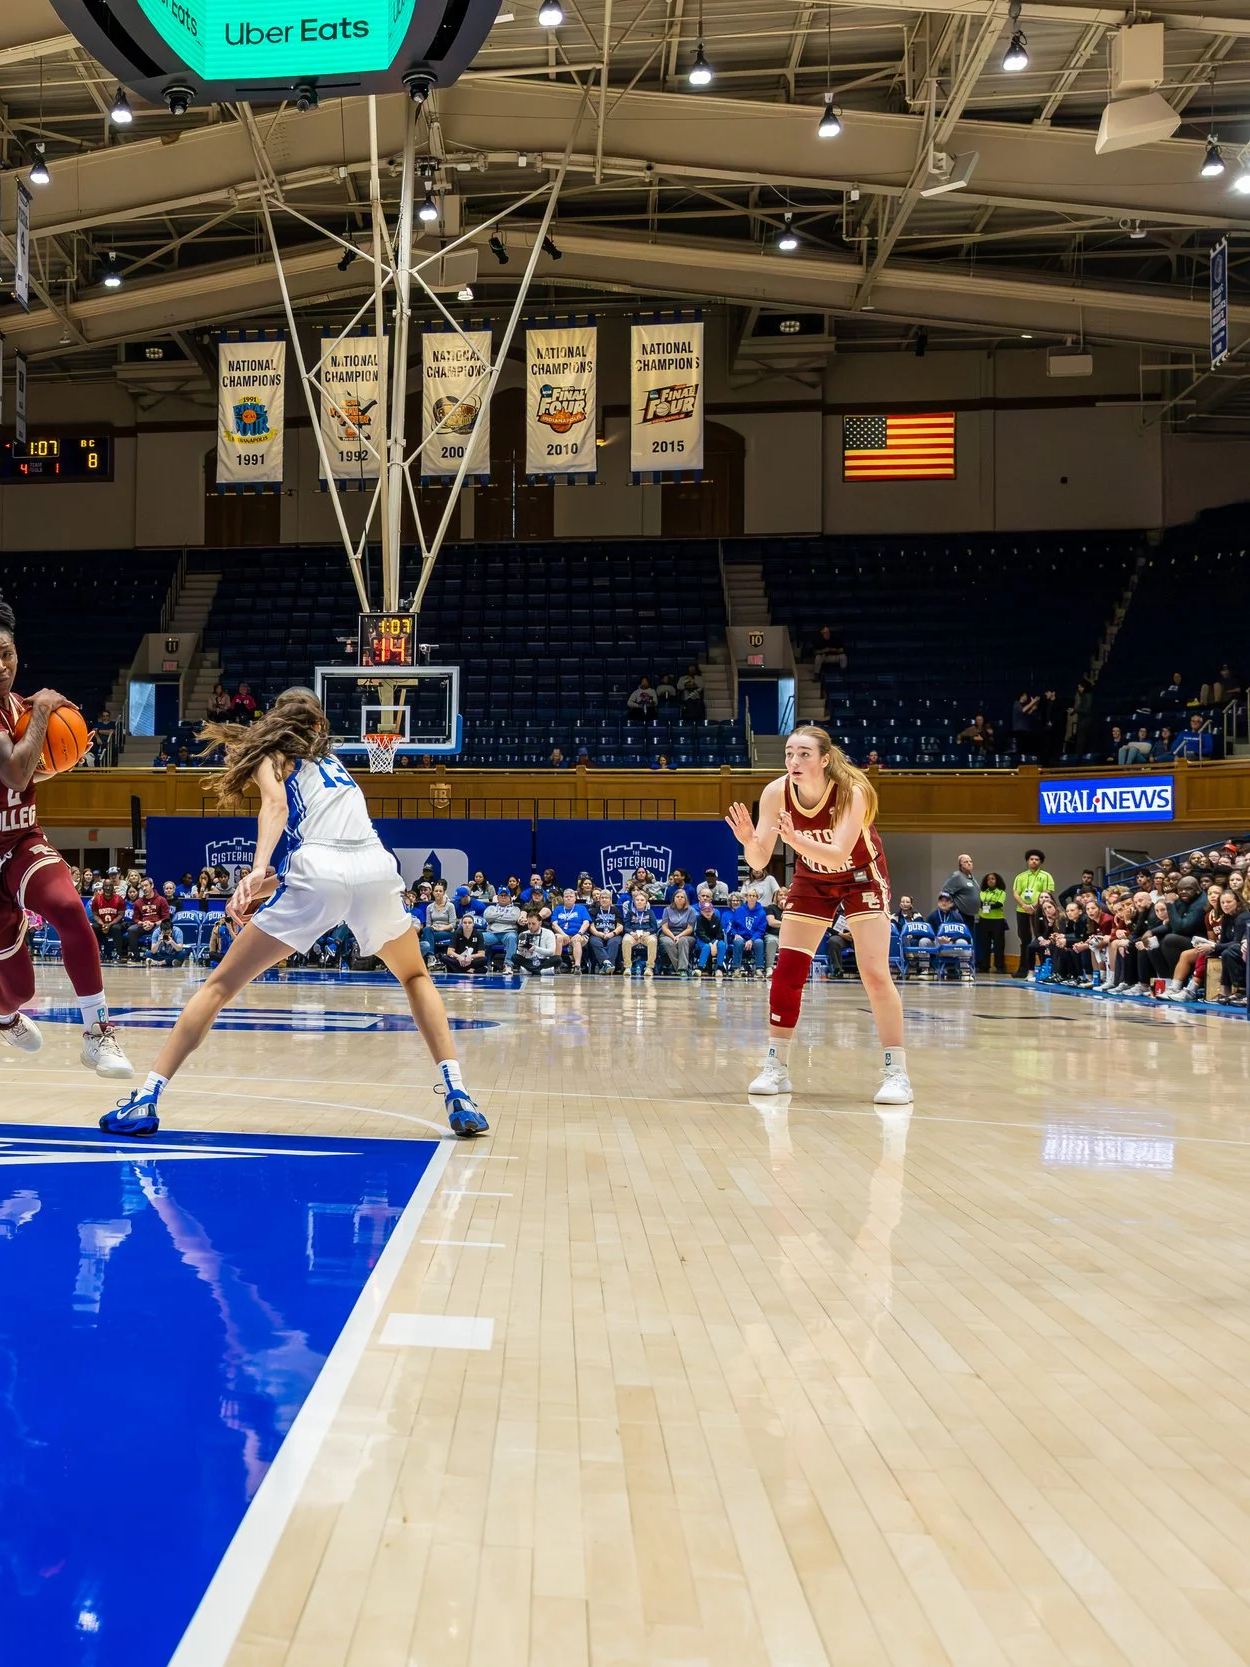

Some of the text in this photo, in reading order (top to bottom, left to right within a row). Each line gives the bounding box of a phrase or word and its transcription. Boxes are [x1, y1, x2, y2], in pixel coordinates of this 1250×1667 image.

[225, 17, 370, 46] Uber Eats
[536, 346, 587, 360] NATIONAL
[642, 341, 693, 355] NATIONAL
[228, 359, 276, 372] NATIONAL
[331, 354, 378, 367] NATIONAL
[635, 357, 700, 372] CHAMPIONS
[531, 361, 593, 376] CHAMPIONS
[222, 374, 281, 388] CHAMPIONS
[325, 370, 378, 383] CHAMPION
[552, 388, 586, 401] FINAL
[661, 387, 696, 402] FINAL
[538, 398, 587, 416] FOUR
[30, 440, 58, 455] 1:07
[441, 446, 467, 458] 200
[546, 443, 579, 456] 2010
[652, 441, 685, 453] 2015
[88, 453, 98, 468] 8
[237, 454, 265, 466] 1991
[338, 450, 369, 462] 1992
[20, 463, 28, 474] 4
[55, 462, 59, 473] 1
[379, 619, 411, 634] 1:07
[751, 635, 763, 646] 10
[381, 638, 405, 662] 14
[1041, 788, 1170, 815] WRAL NEWS
[211, 851, 254, 866] SISTERHO
[606, 856, 666, 872] SISTERHOOD
[177, 911, 196, 920] DUKE
[907, 923, 928, 932] DUKE
[944, 924, 965, 934] DUKE
